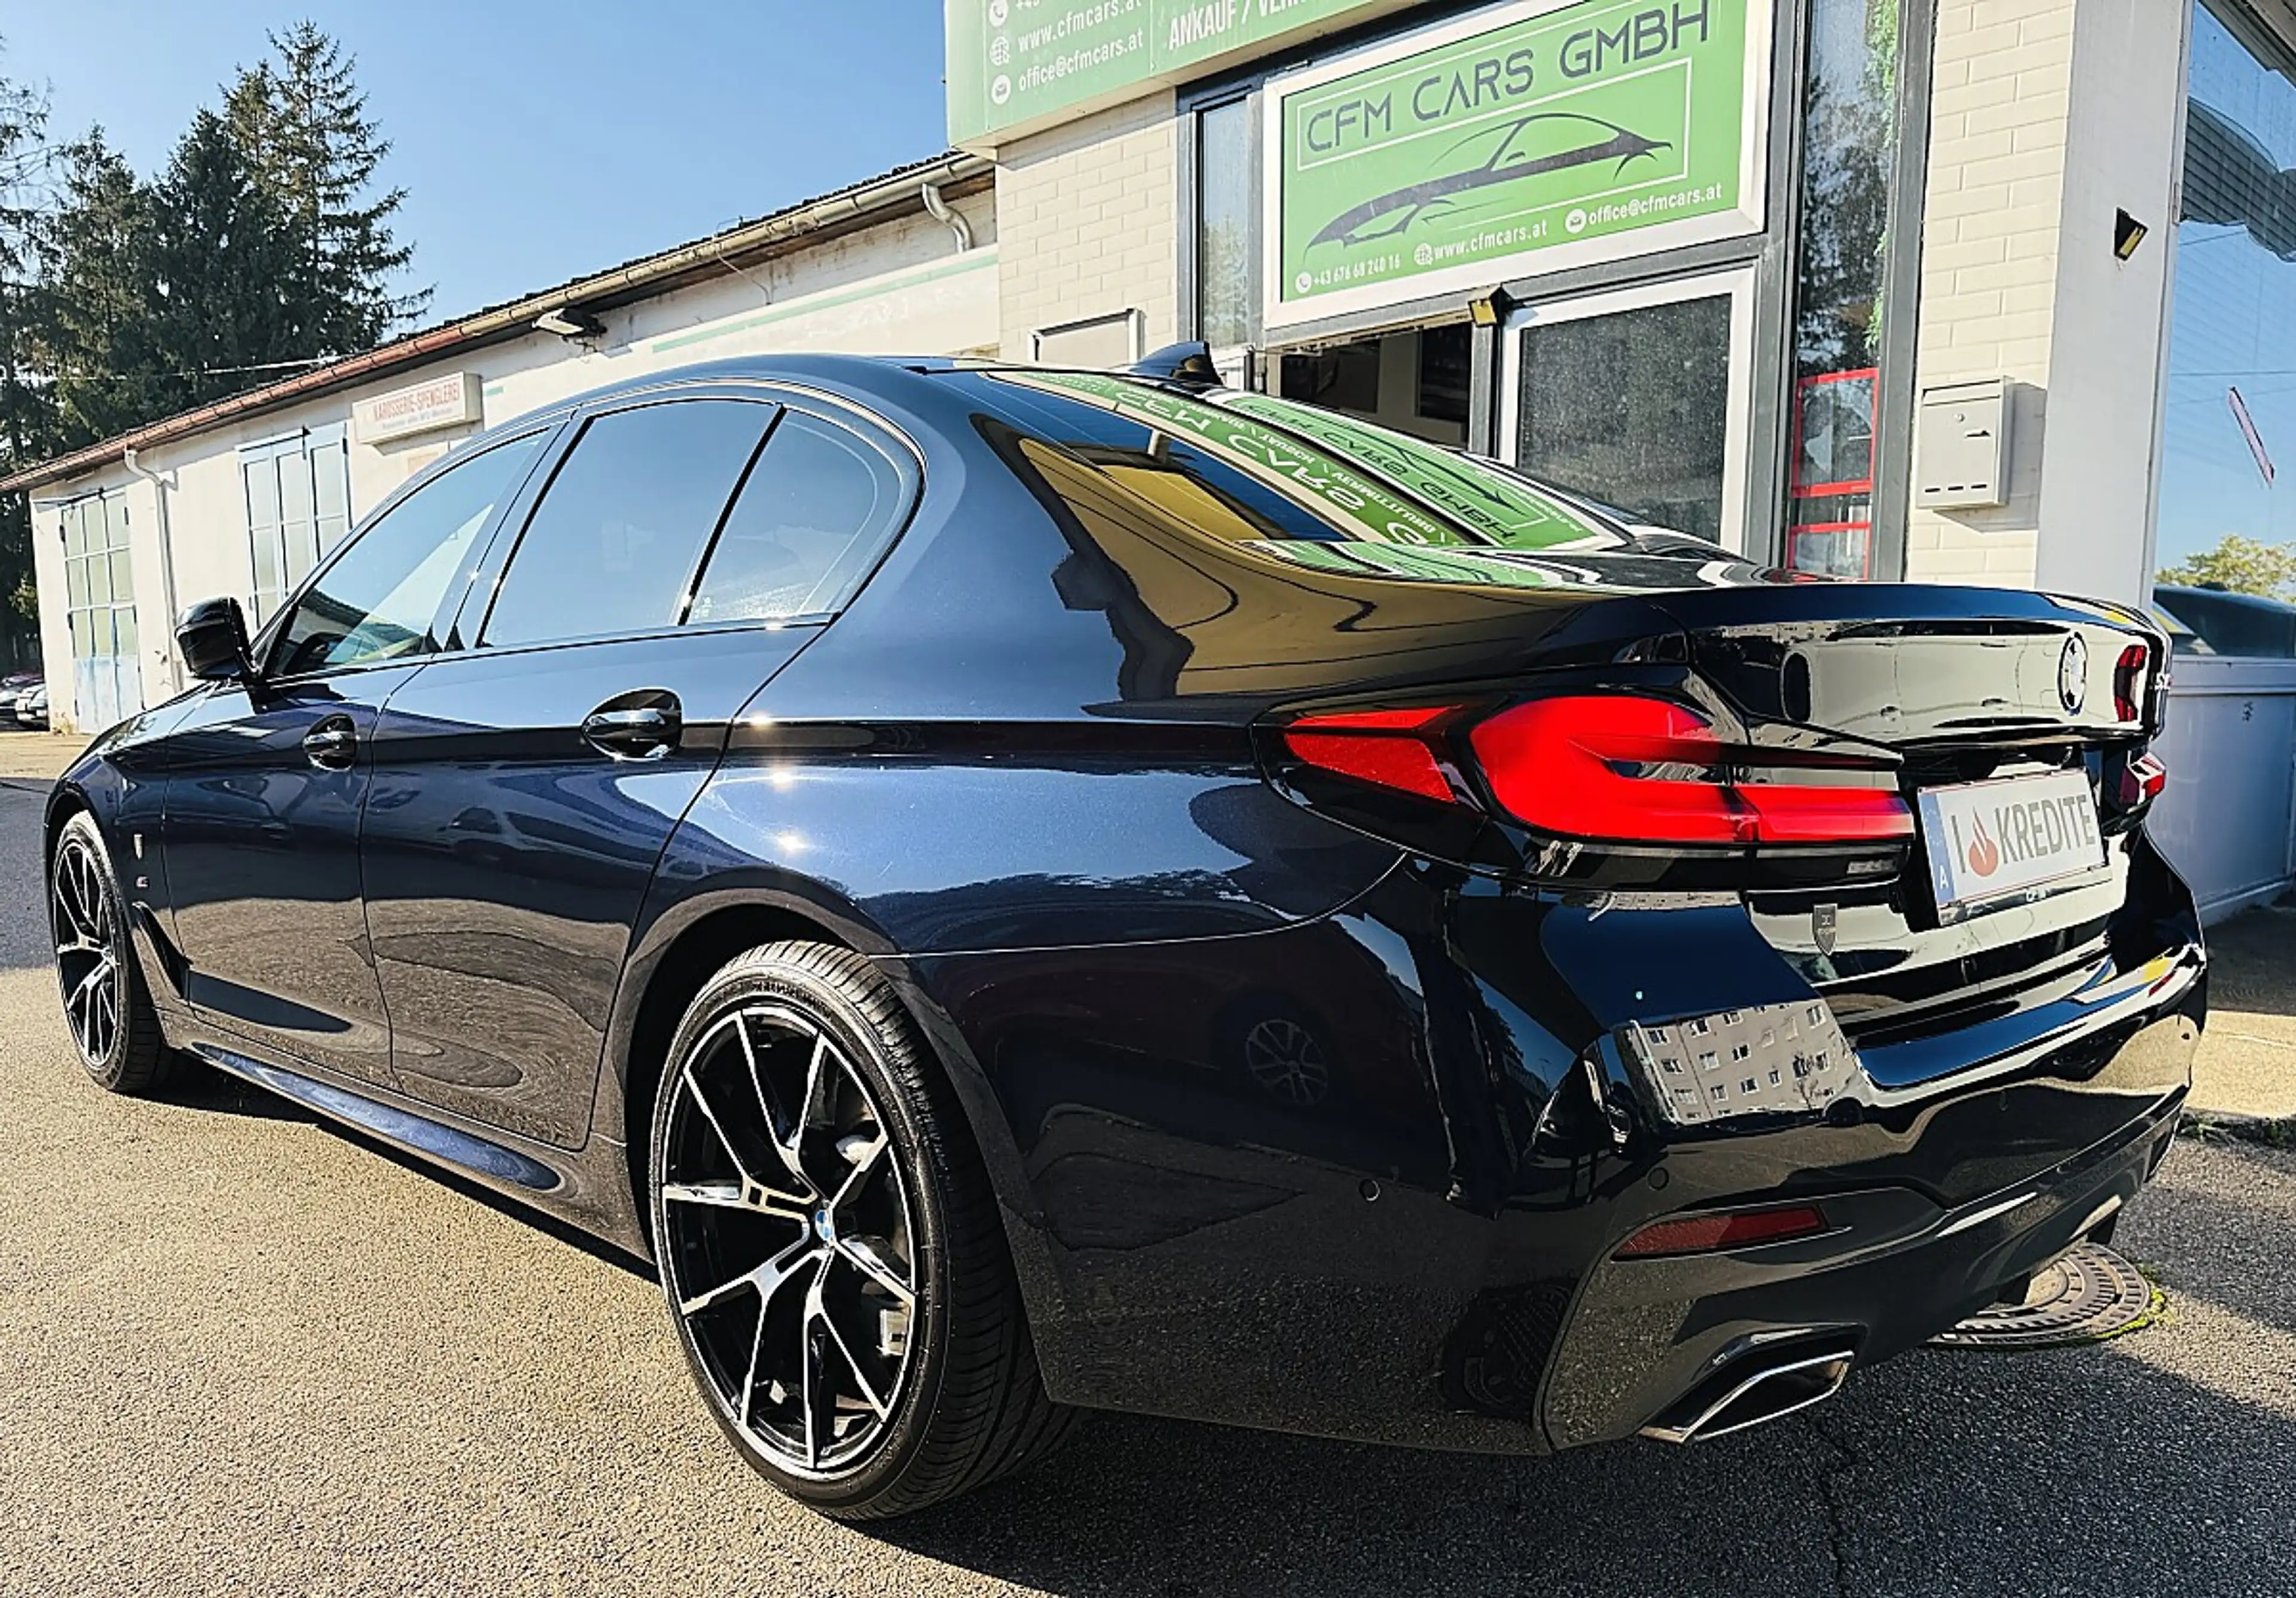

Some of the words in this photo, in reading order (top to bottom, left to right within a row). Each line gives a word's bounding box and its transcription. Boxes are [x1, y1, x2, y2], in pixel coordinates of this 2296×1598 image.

[1168, 0, 1237, 51] ANKAUF
[1019, 27, 1143, 91] office@cfmcars.at
[1306, 92, 1392, 153] CFM
[1412, 48, 1534, 121] CARS
[1559, 0, 1708, 80] GMBH
[1588, 182, 1723, 225] office@cfmcars.at
[1435, 221, 1547, 260] www.cfmcars.at
[1939, 864, 1948, 889] A
[1994, 794, 2095, 865] KREDITE
